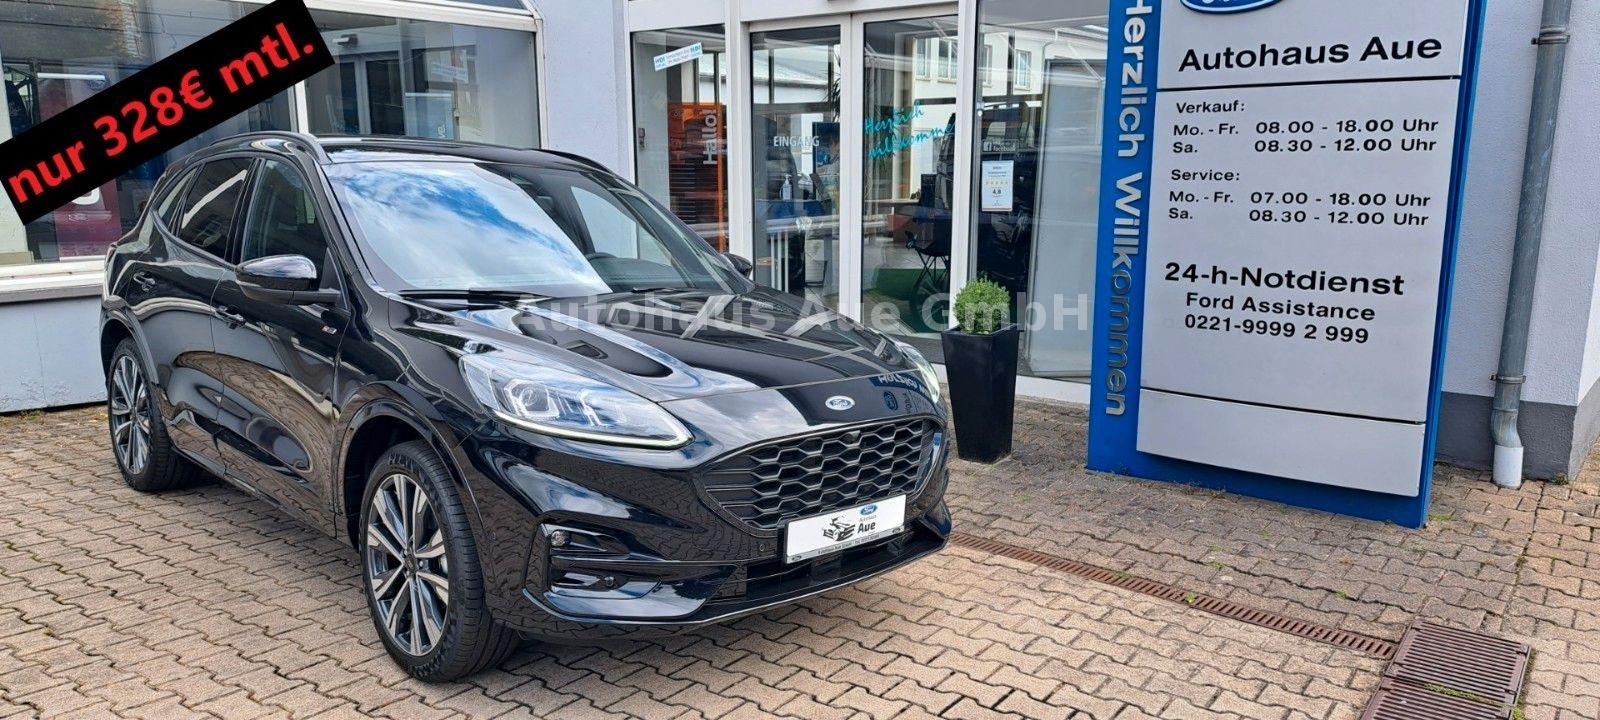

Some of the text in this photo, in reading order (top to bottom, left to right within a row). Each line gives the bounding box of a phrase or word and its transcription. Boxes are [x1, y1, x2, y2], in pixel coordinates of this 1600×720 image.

[1179, 36, 1442, 73] Autohaus Aue
[865, 99, 925, 134] Herzlich
[1175, 100, 1245, 114] Verkauf:
[701, 109, 718, 165] Hallo!
[1173, 124, 1204, 136] Mo.
[1218, 123, 1239, 135] Fr.
[1255, 121, 1314, 134] 08.00
[1336, 119, 1394, 133] 18.00
[1402, 118, 1438, 132] Uhr
[773, 135, 820, 147] EINGANG
[868, 122, 956, 159] willkomme
[1172, 142, 1198, 154] Sa.
[1254, 139, 1312, 152] 08.30
[1334, 138, 1392, 152] 12.00
[1400, 138, 1437, 152] Uhr
[1171, 169, 1240, 181] Service:
[1105, 0, 1153, 416] Herzlich Willkommen
[1169, 191, 1200, 203] Mo.
[1213, 191, 1234, 204] Fr.
[1250, 191, 1308, 205] 07.00
[1329, 193, 1387, 206] 18.00
[1395, 193, 1431, 207] Uhr
[1168, 208, 1193, 220] Sa.
[1249, 209, 1307, 223] 08.30
[1327, 211, 1385, 225] 12.00
[1393, 212, 1429, 226] Uhr
[1164, 261, 1405, 296] 24-h-Notdienst
[1186, 291, 1376, 322] Ford Assistance
[1184, 313, 1370, 344] 0221-9999 2 999
[857, 521, 877, 534] Aue
